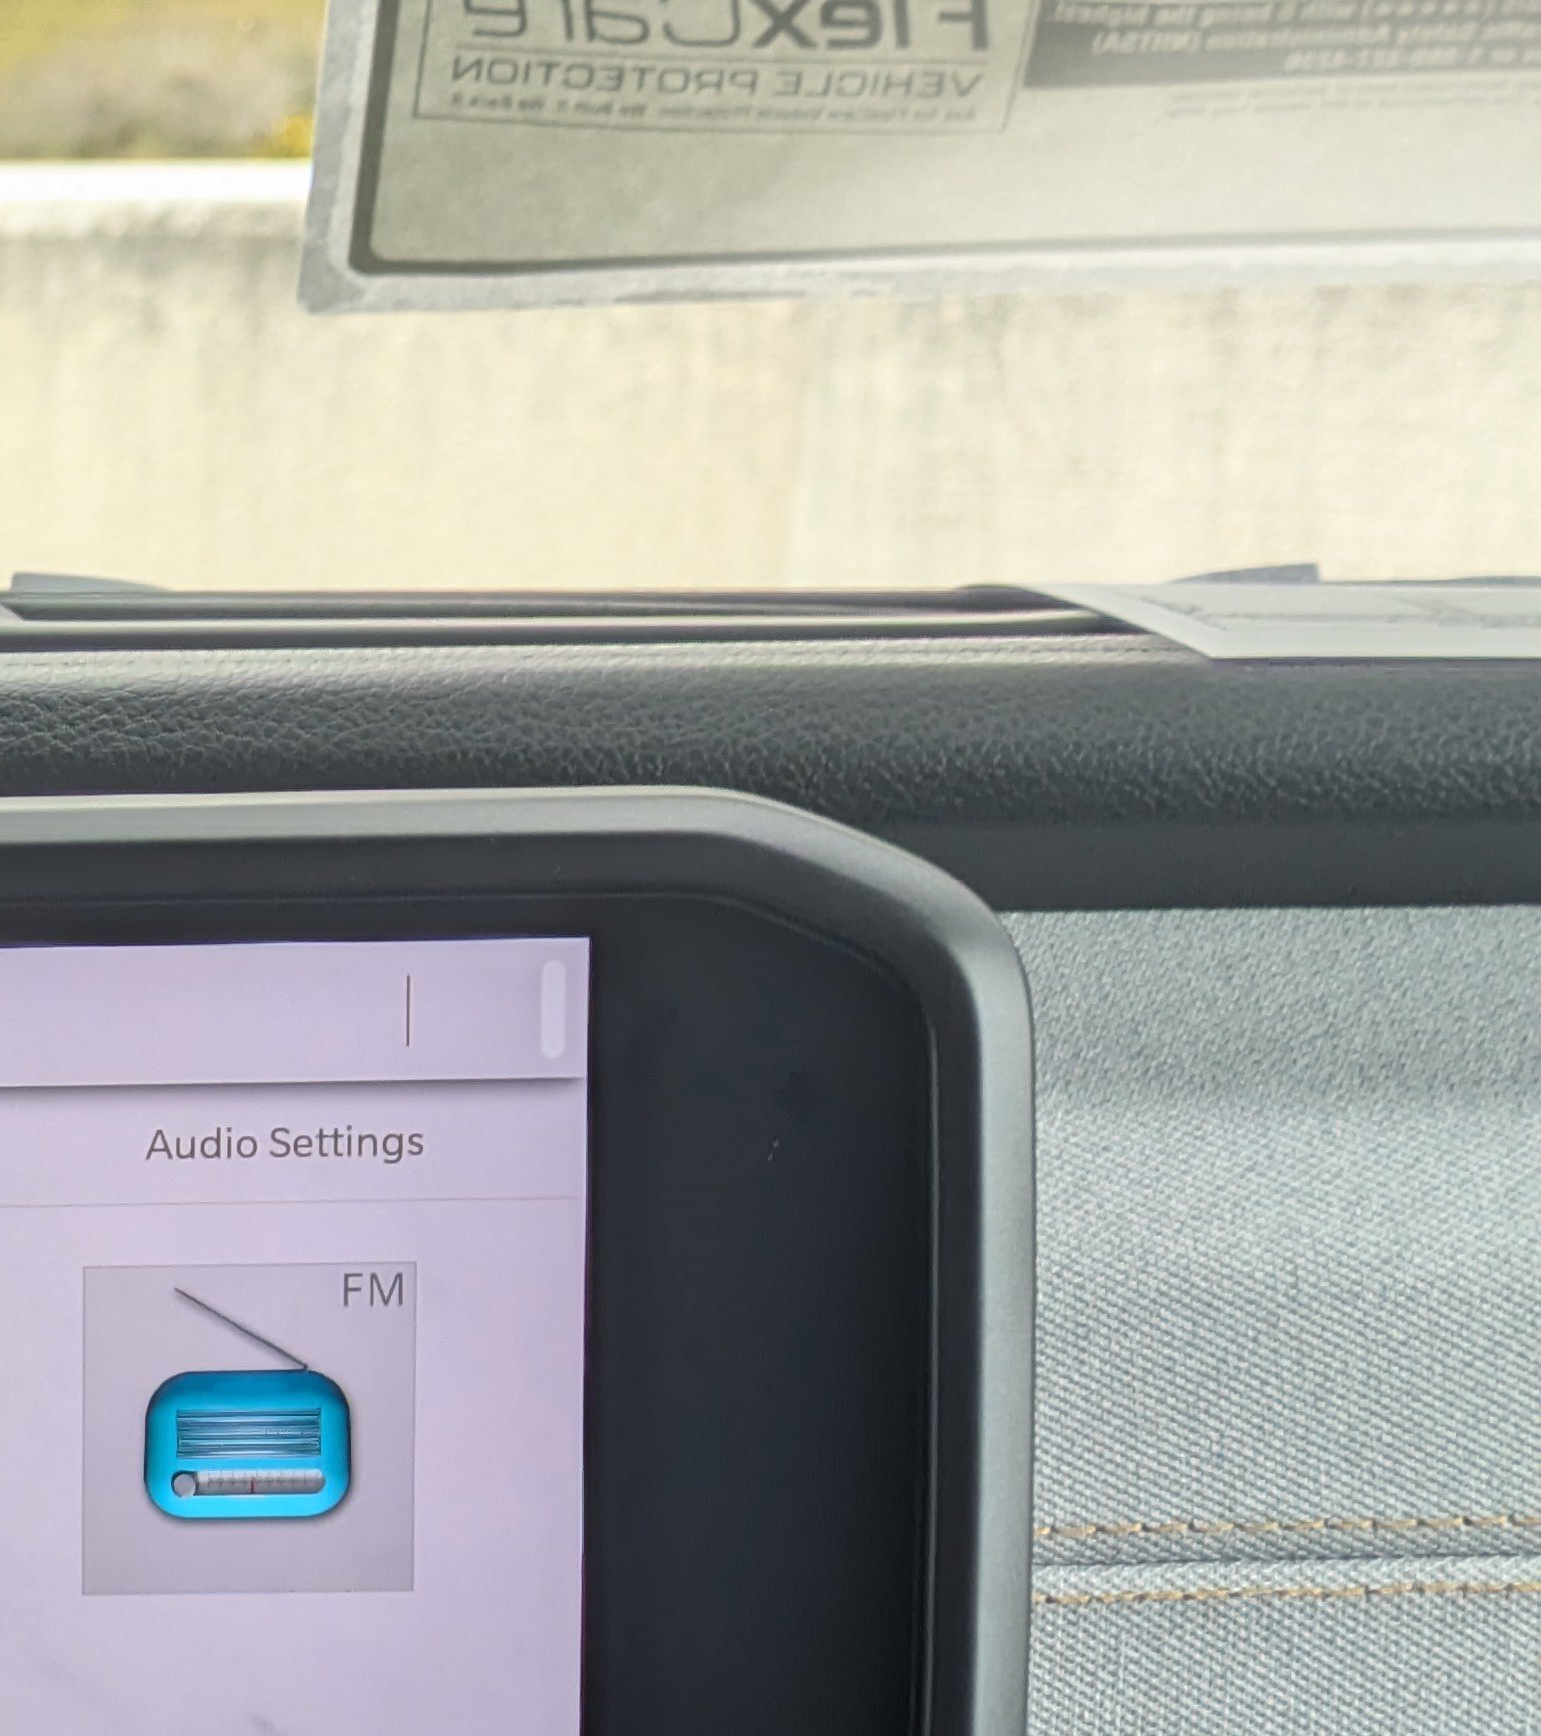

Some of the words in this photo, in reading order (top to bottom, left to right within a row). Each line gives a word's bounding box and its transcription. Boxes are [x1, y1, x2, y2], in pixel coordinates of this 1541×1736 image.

[146, 1127, 257, 1160] Audio
[270, 1125, 424, 1165] Settings
[344, 1273, 404, 1307] FM
